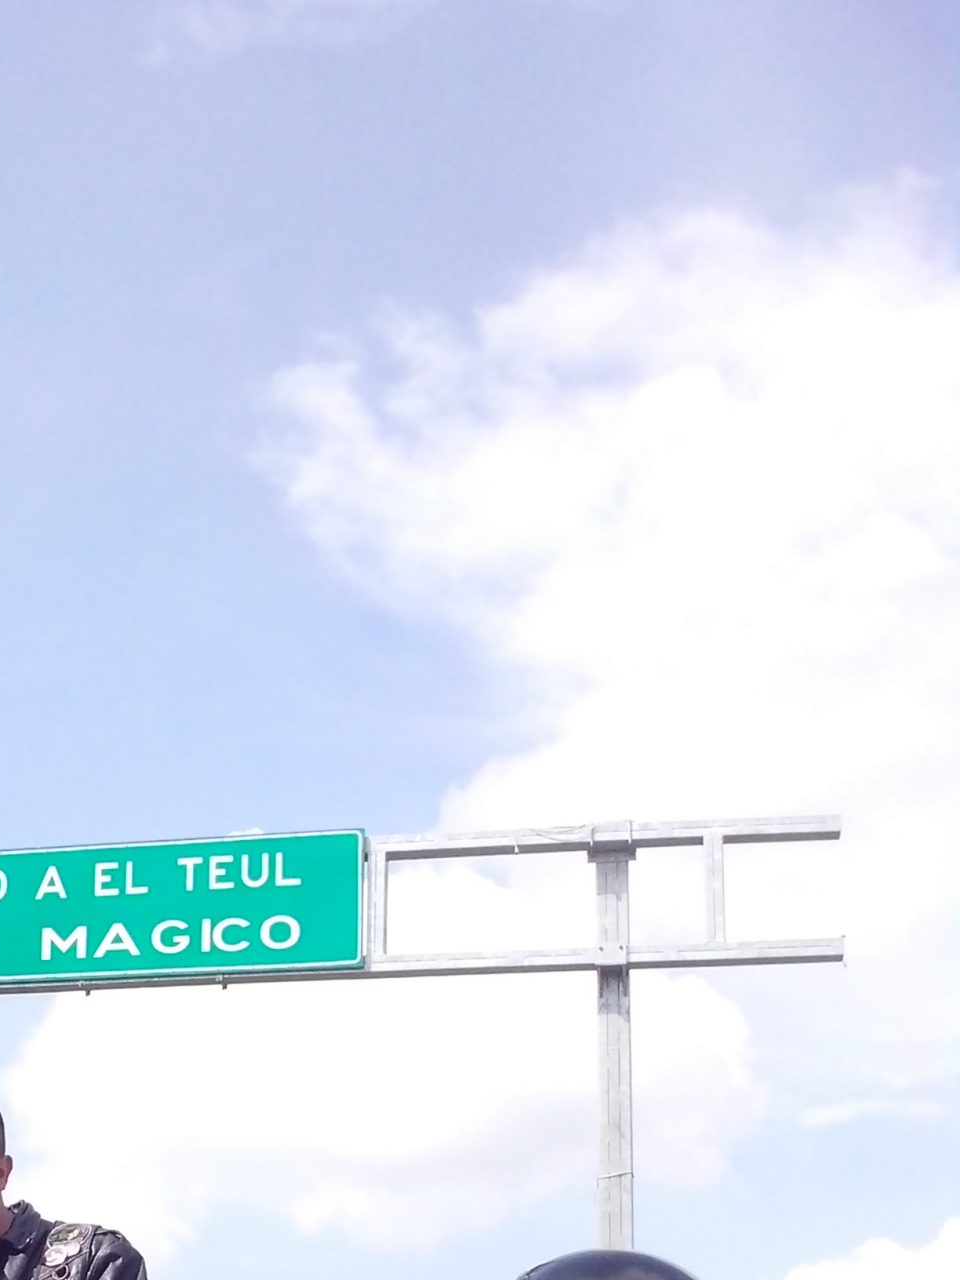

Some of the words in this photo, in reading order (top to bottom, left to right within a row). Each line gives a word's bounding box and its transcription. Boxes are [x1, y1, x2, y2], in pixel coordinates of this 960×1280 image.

[35, 865, 68, 900] A
[93, 861, 149, 897] EL
[176, 851, 302, 892] TEUL
[41, 915, 301, 961] MAGICO
